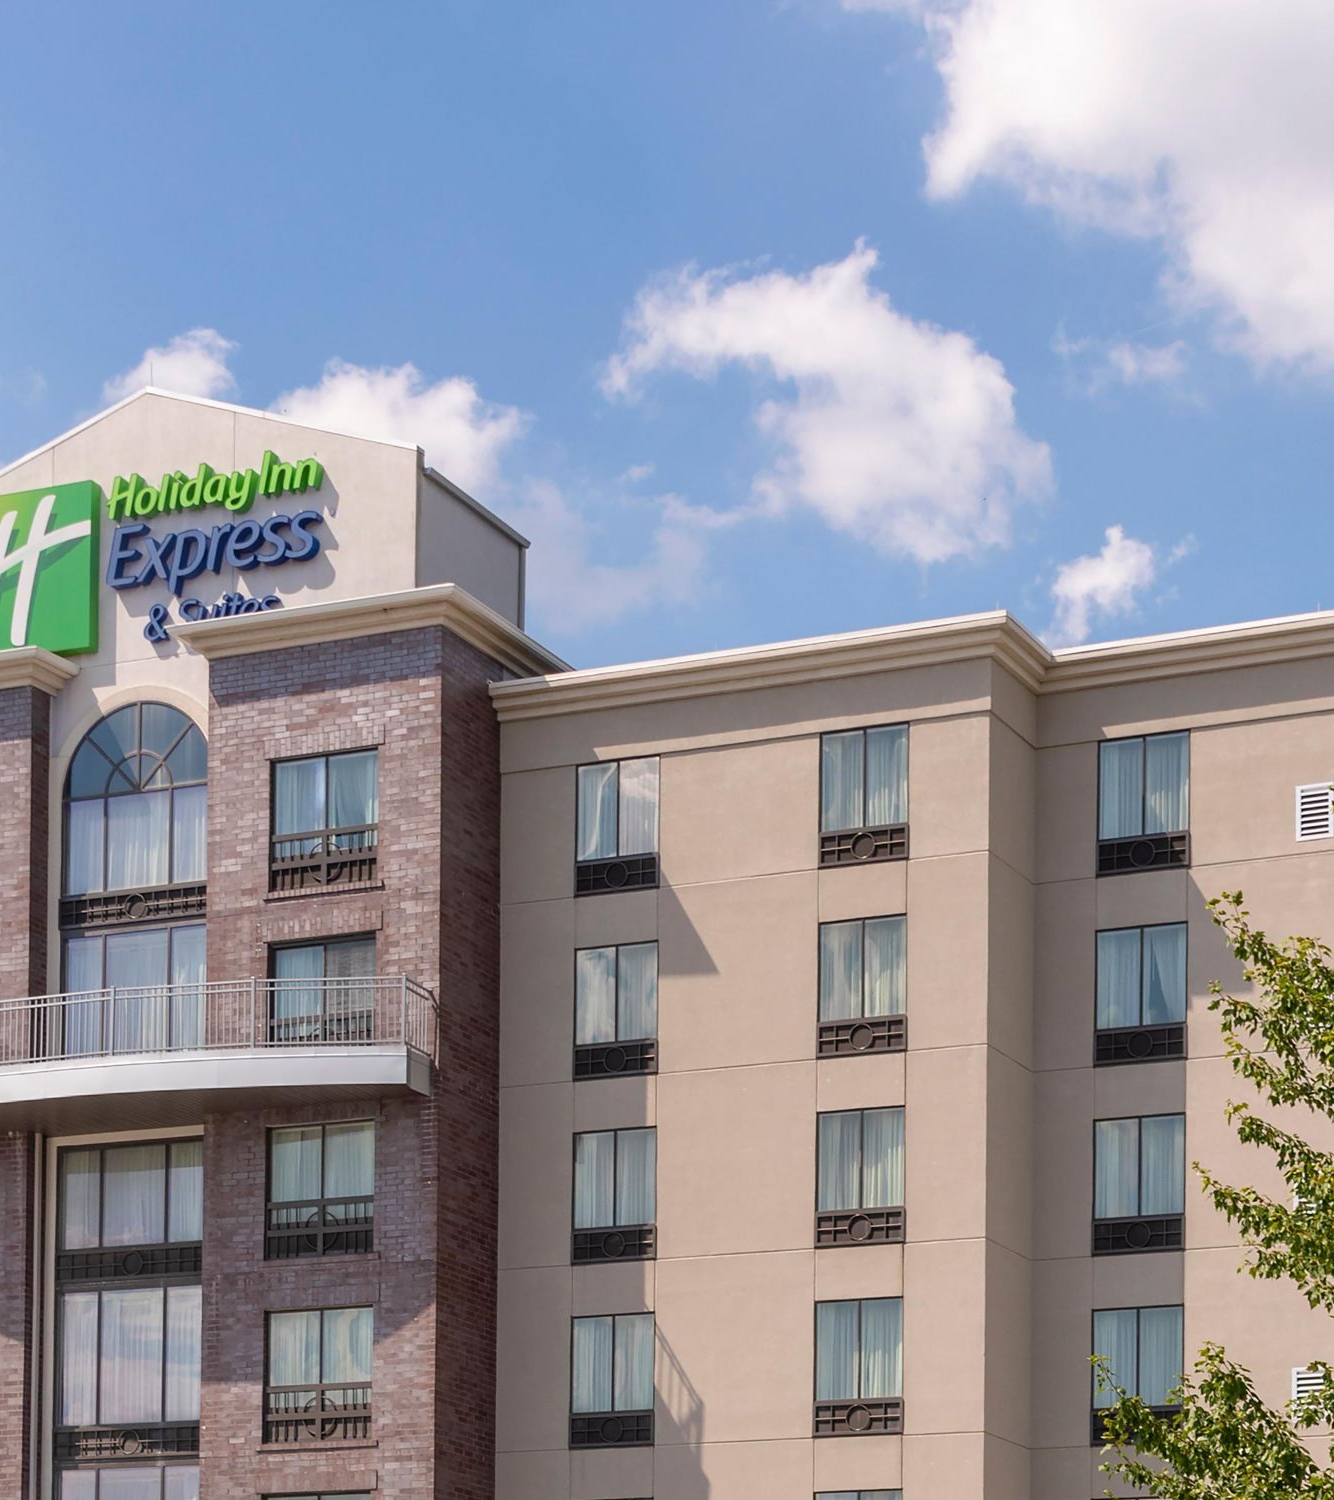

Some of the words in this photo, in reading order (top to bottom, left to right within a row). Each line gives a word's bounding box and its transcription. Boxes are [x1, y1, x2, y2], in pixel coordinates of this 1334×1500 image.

[107, 462, 260, 523] Holiday
[258, 450, 324, 498] Inn
[106, 510, 323, 597] Express
[143, 603, 170, 642] &
